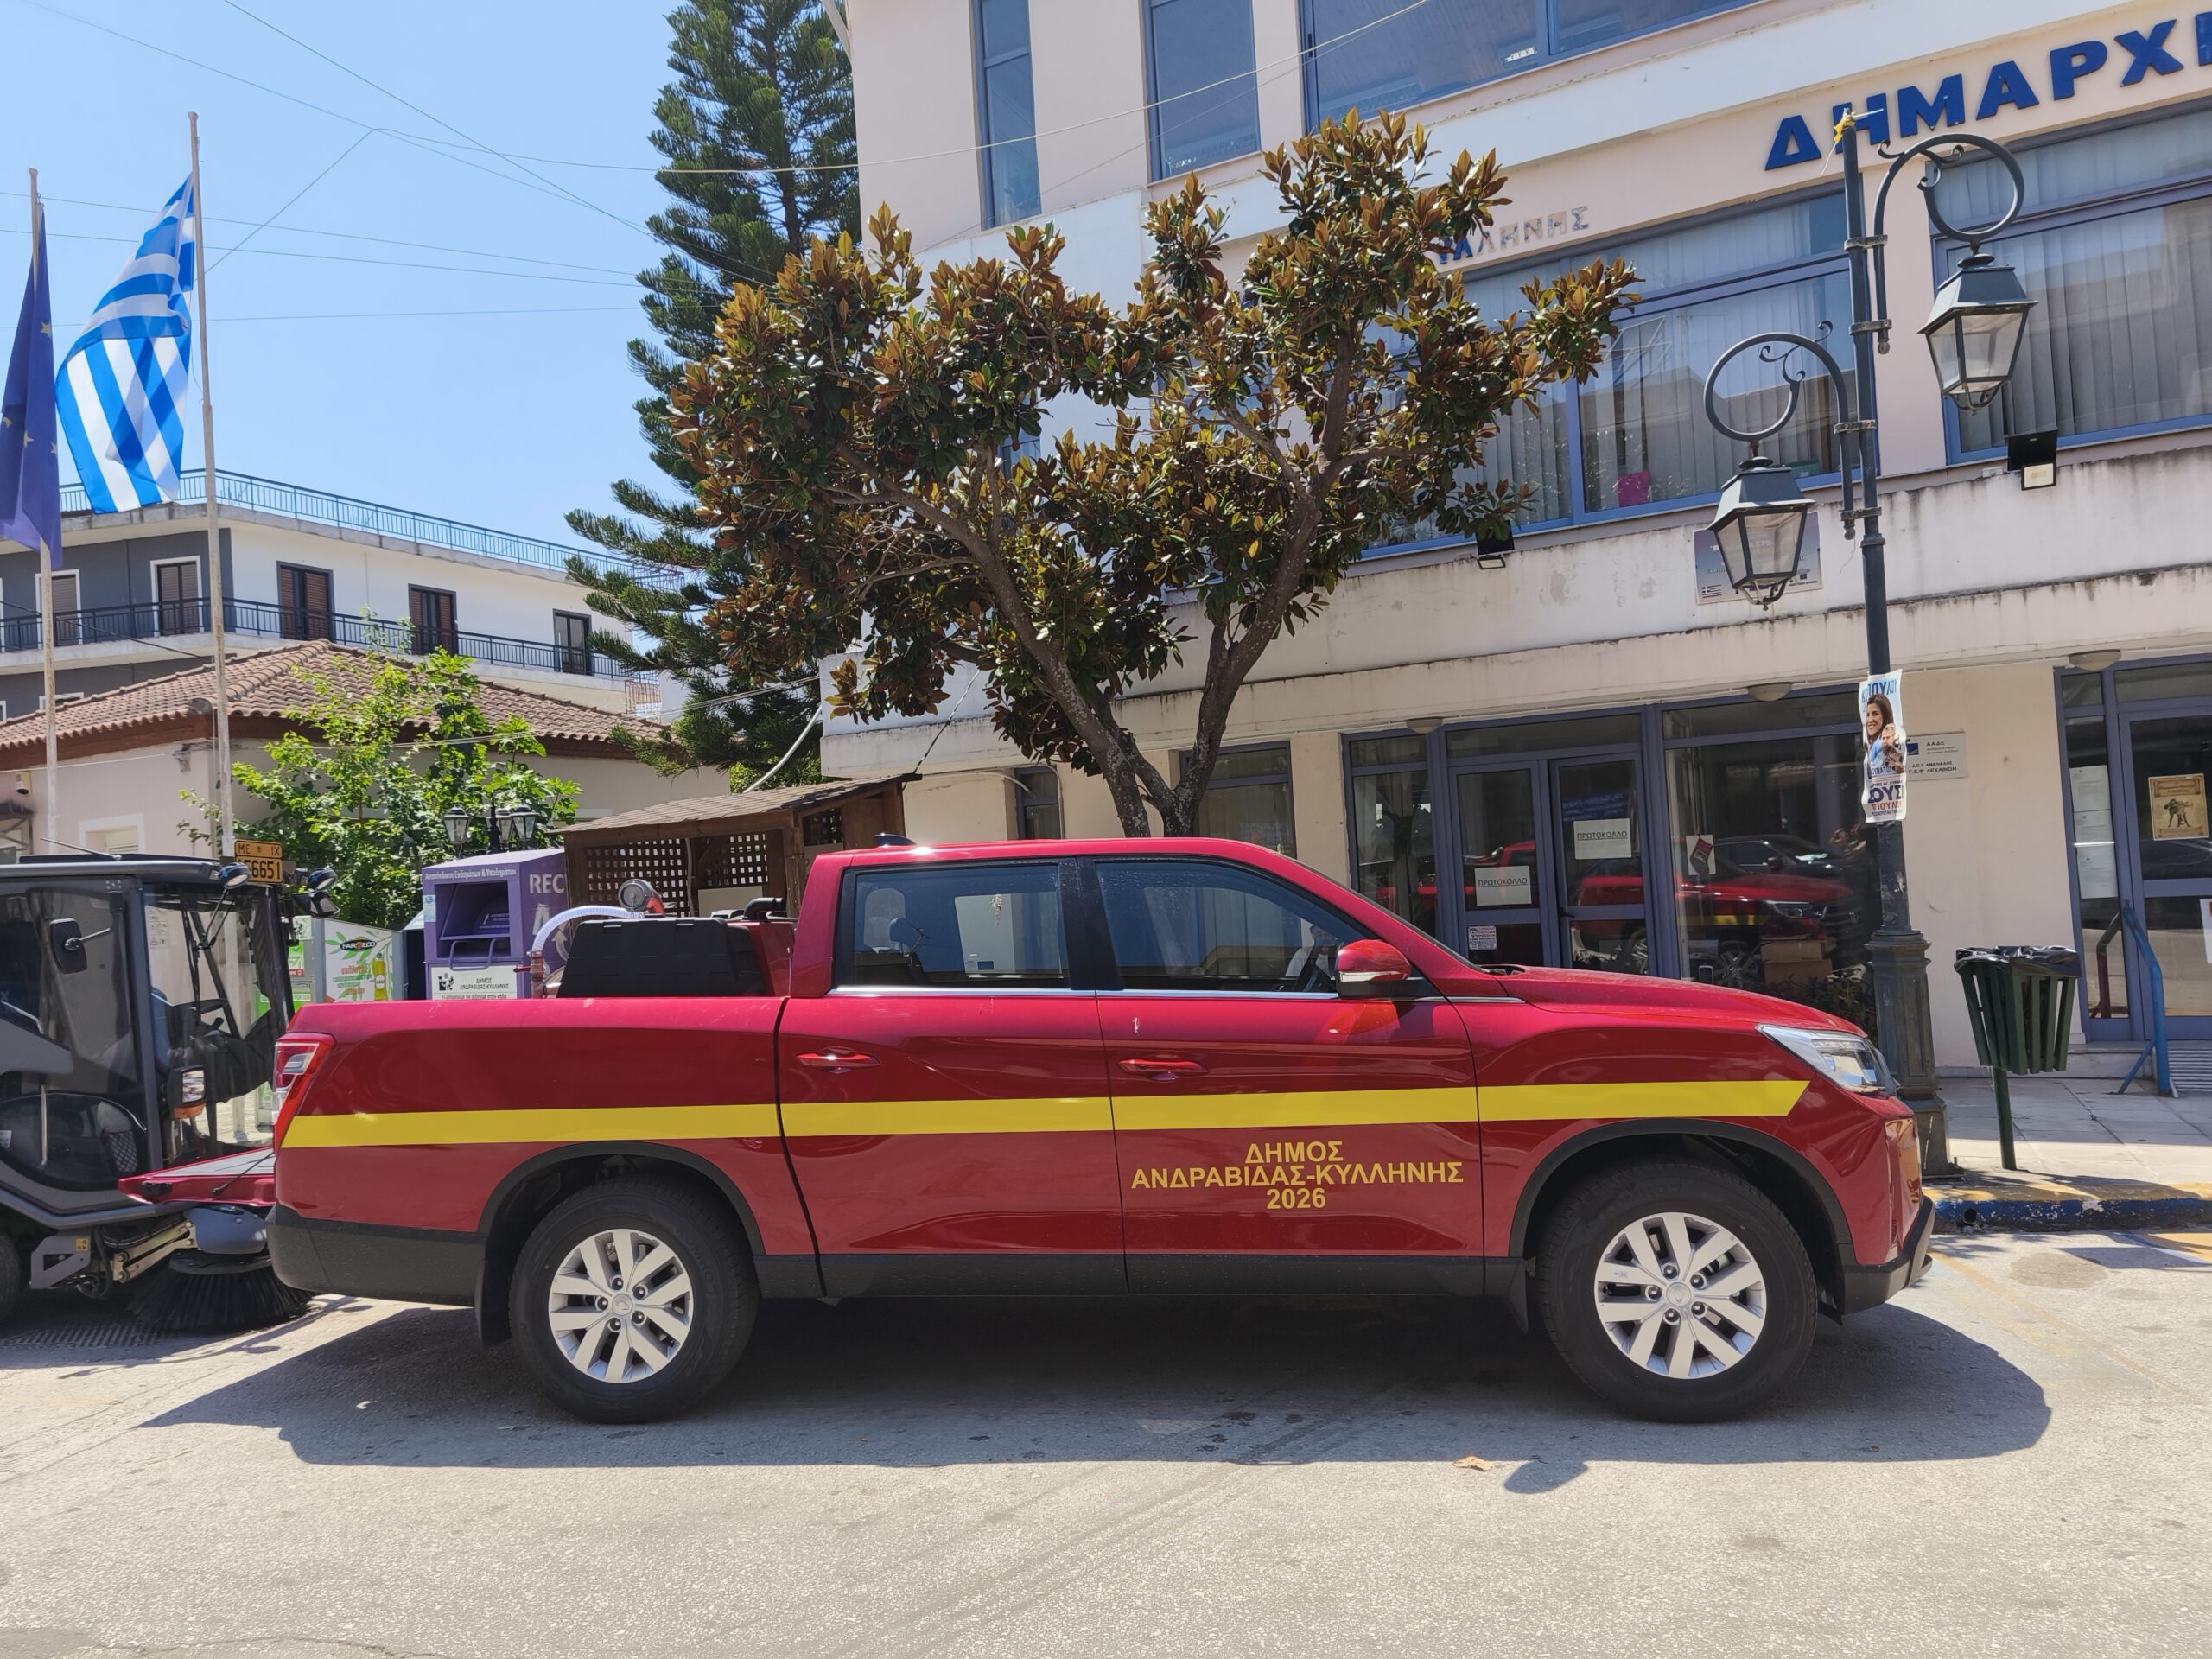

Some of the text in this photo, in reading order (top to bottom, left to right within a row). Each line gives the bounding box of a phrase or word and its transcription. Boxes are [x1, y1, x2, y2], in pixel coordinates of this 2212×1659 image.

[1577, 830, 1628, 842] ΠΡΩΤΟΚΟΛΛΟ
[237, 859, 281, 880] 6651
[529, 873, 568, 894] REC
[1478, 876, 1528, 887] ΠΡΩΤΟΚΟΛΛΟ
[1245, 1141, 1344, 1164] ΔΗΜΟΣ
[1131, 1161, 1464, 1189] ΑΝΔΡΑΒΙΔΑΣ-ΚΥΛΛΗΝΗΣ
[1266, 1188, 1326, 1210] 2026
